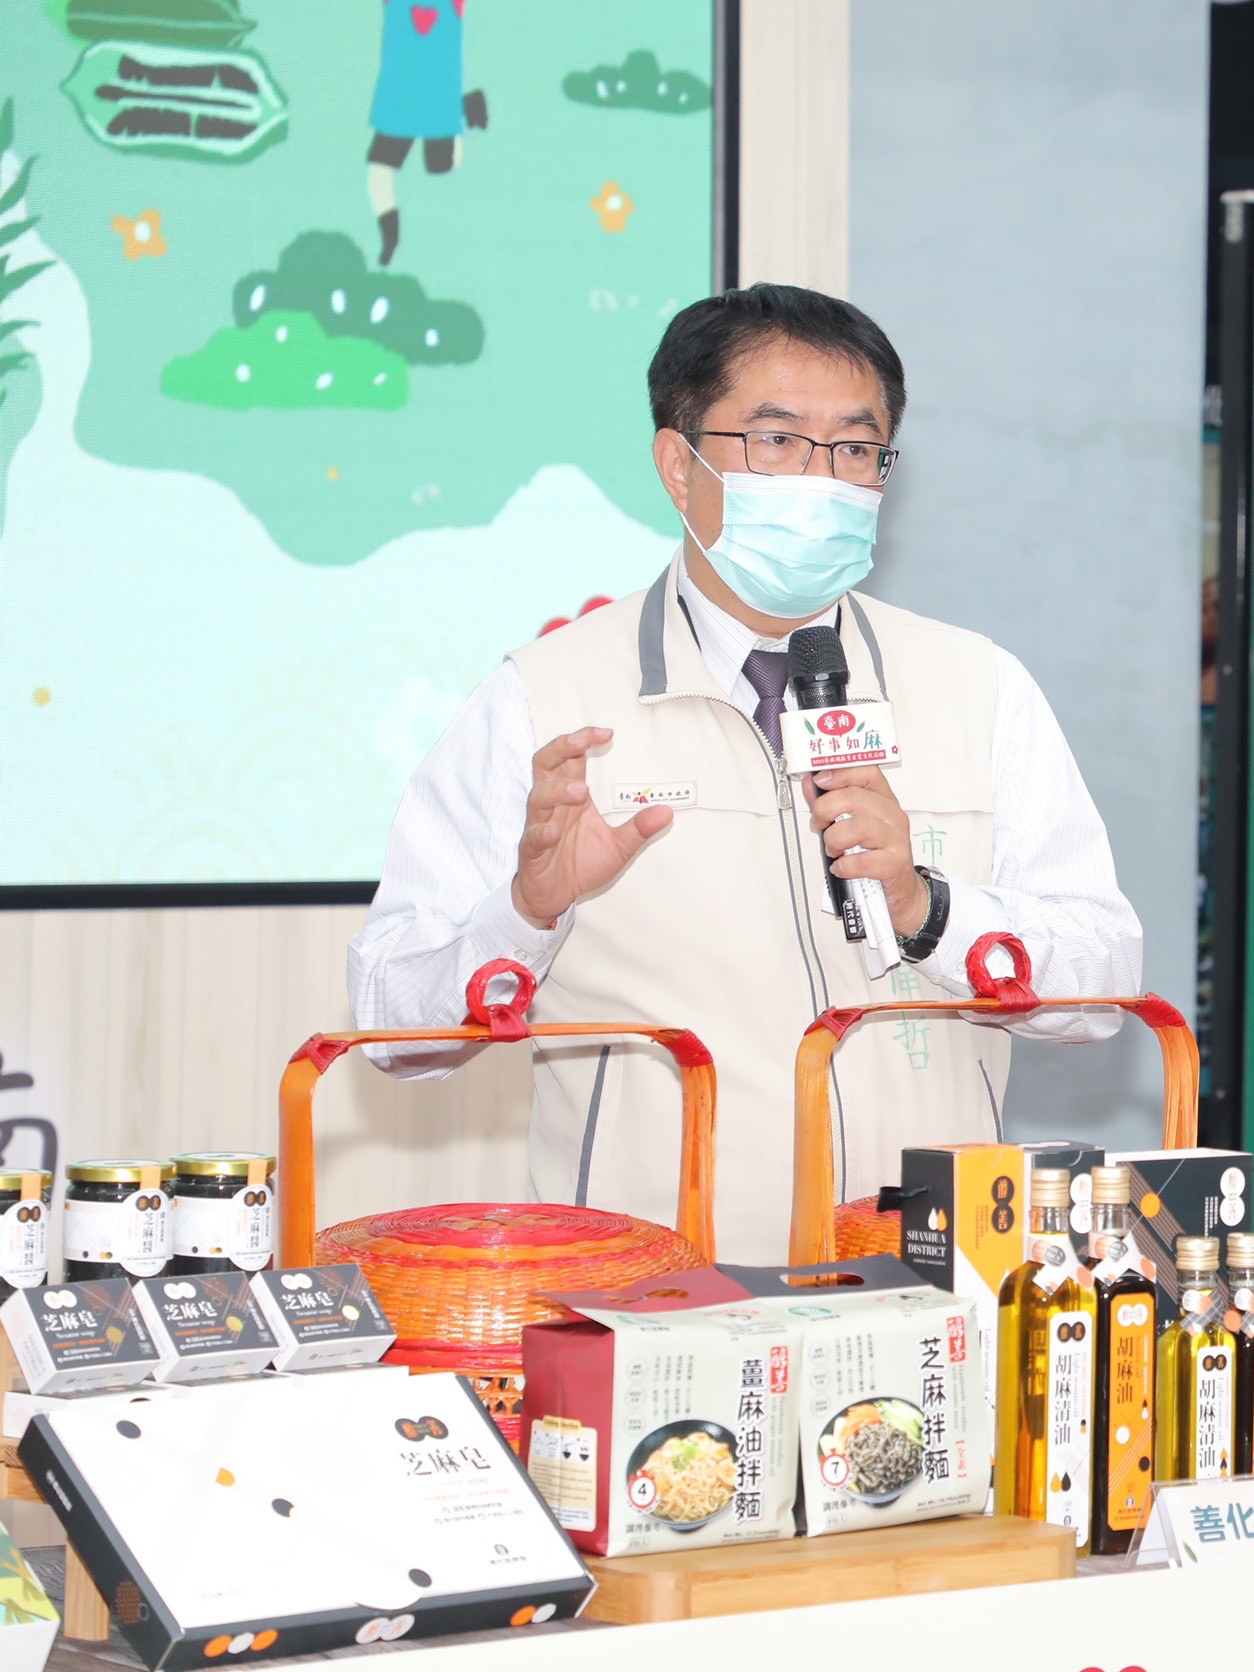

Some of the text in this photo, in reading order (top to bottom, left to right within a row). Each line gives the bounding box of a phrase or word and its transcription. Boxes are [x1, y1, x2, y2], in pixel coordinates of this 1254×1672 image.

[822, 714, 850, 731] 臺南
[809, 730, 883, 754] 好事如麻
[906, 1230, 947, 1244] SHANHUA
[907, 1244, 947, 1258] DISTRICT
[162, 1301, 218, 1321] 芝麻皂
[279, 1291, 335, 1311] 芝麻皂
[40, 1311, 98, 1332] 芝麻皂
[1117, 1336, 1134, 1405] 胡麻油
[919, 1336, 950, 1484] 芝麻拌麵
[1055, 1354, 1073, 1446] 胡麻清油
[1199, 1378, 1216, 1468] 胡麻清油
[736, 1359, 765, 1521] 薑麻油拌麵
[400, 1446, 492, 1477] 芝麻皂
[830, 1461, 839, 1476] 7
[638, 1483, 647, 1498] 4
